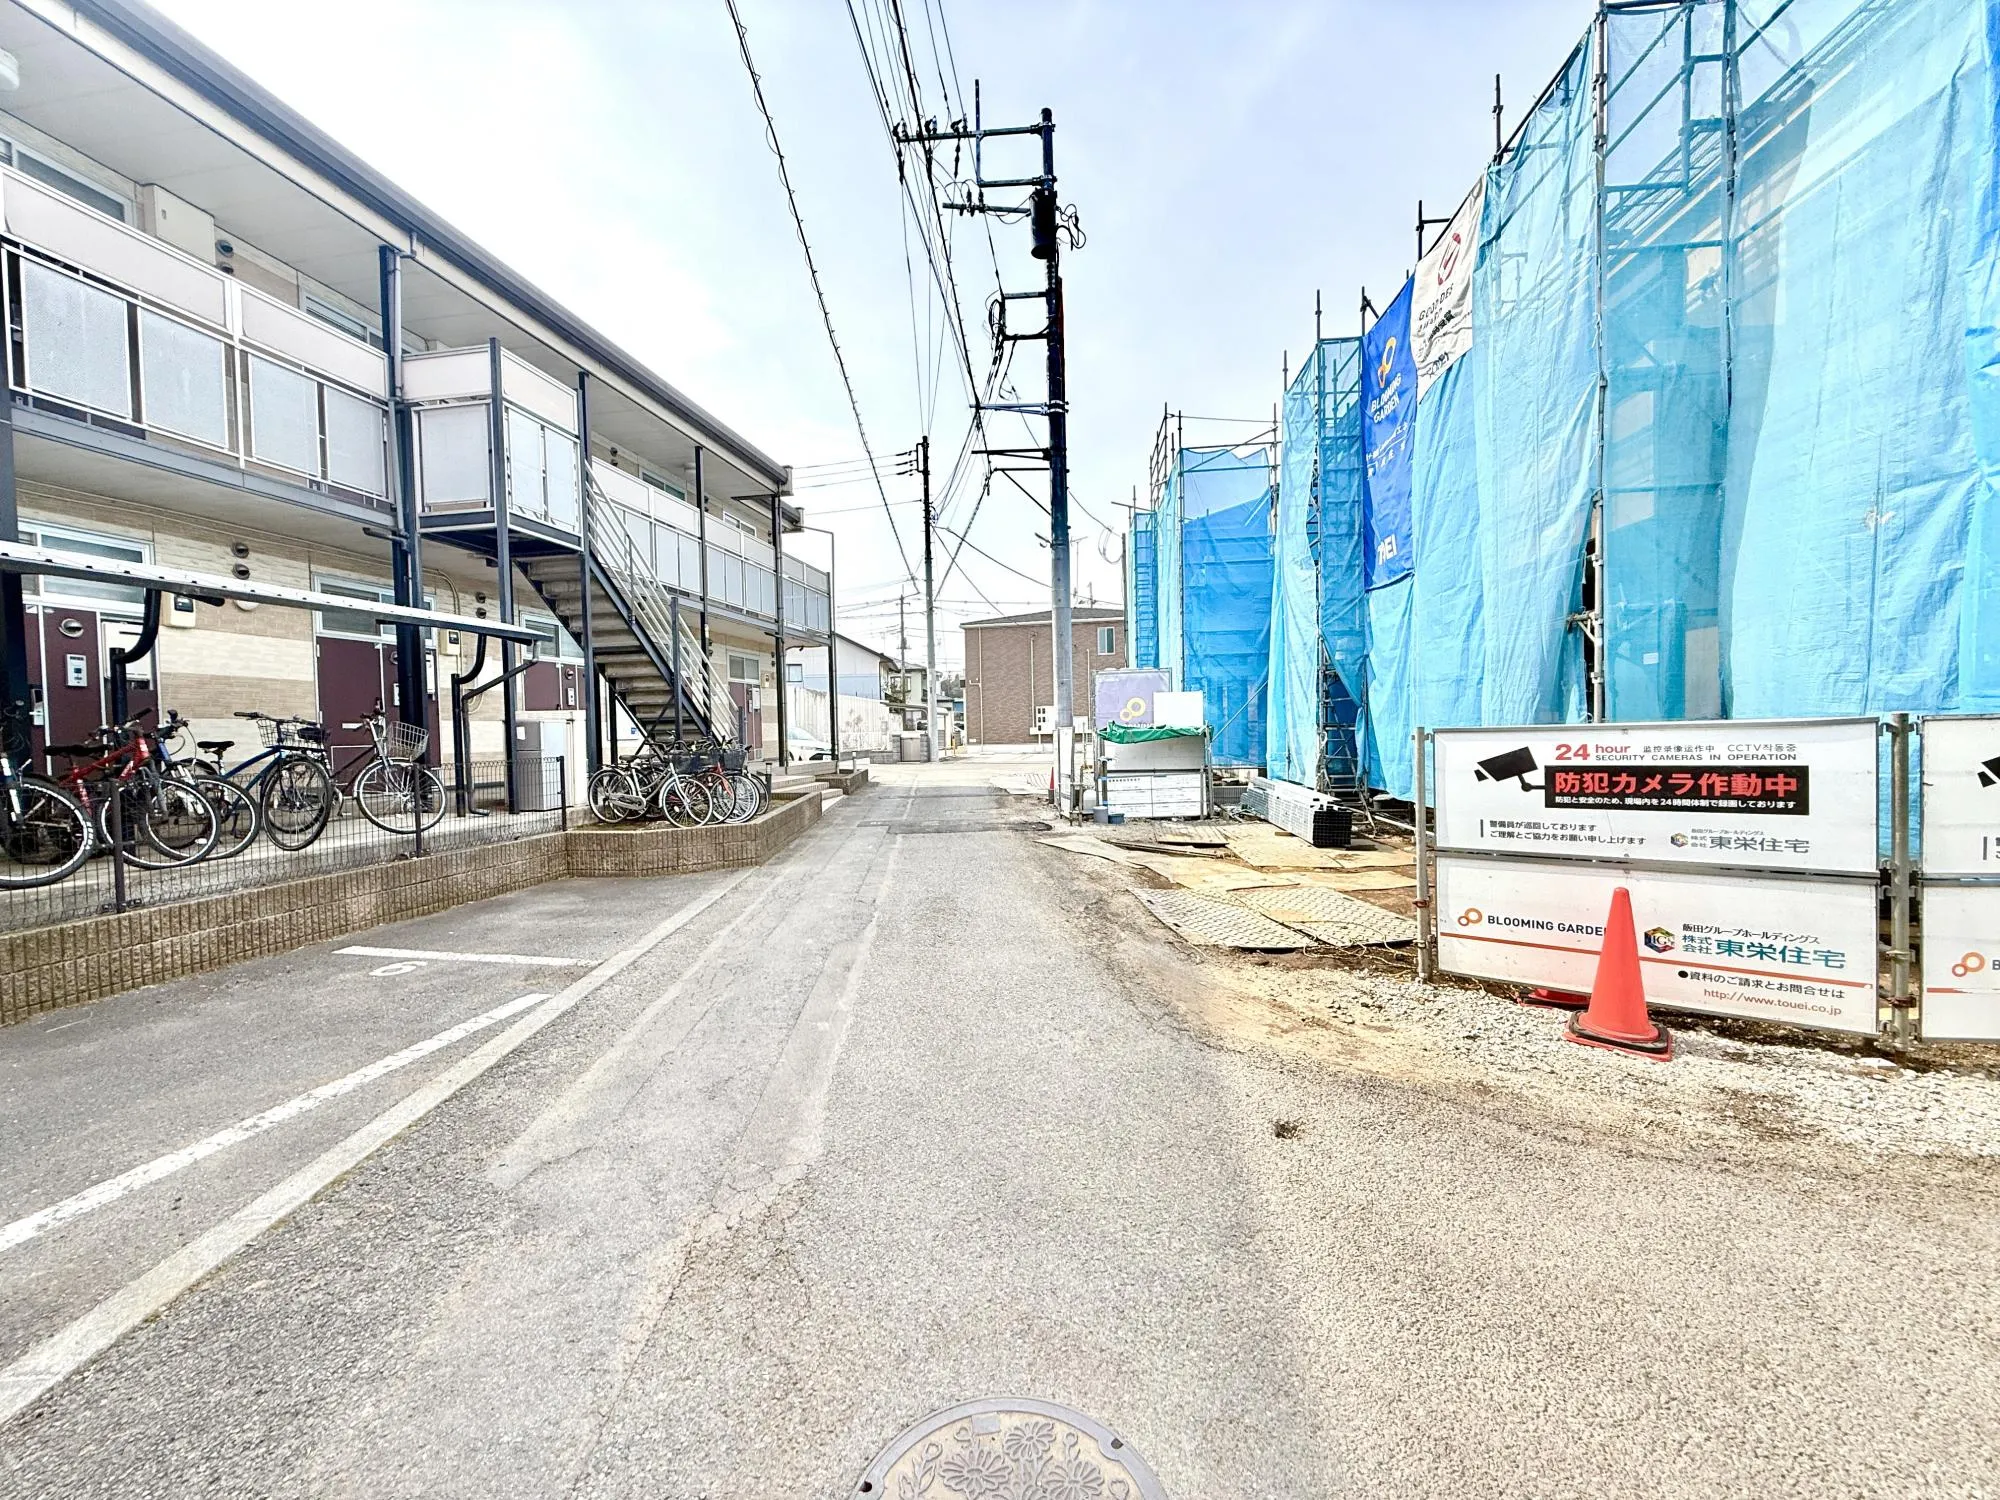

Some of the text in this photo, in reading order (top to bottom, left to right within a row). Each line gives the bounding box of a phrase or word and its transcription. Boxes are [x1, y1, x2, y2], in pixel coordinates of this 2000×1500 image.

[1371, 372, 1402, 412] BLOOMING
[1373, 392, 1400, 424] GARDEN
[1555, 743, 1590, 761] 24
[1595, 744, 1631, 754] hour
[1727, 753, 1797, 761] OPERATION
[1555, 771, 1798, 798] 防犯カメラ作動中
[1489, 819, 1597, 832] 警備員が巡回しております
[1490, 831, 1647, 845] ご理解とご協力をお願い申し上げます
[1709, 835, 1810, 853] 東栄住宅
[1487, 915, 1606, 936] BLOOMING GARDE
[1682, 923, 1820, 945] 飯田グループホールディングス
[1715, 938, 1846, 969] 東栄住宅
[1703, 988, 1842, 1016] http://www.touei.co.jp
